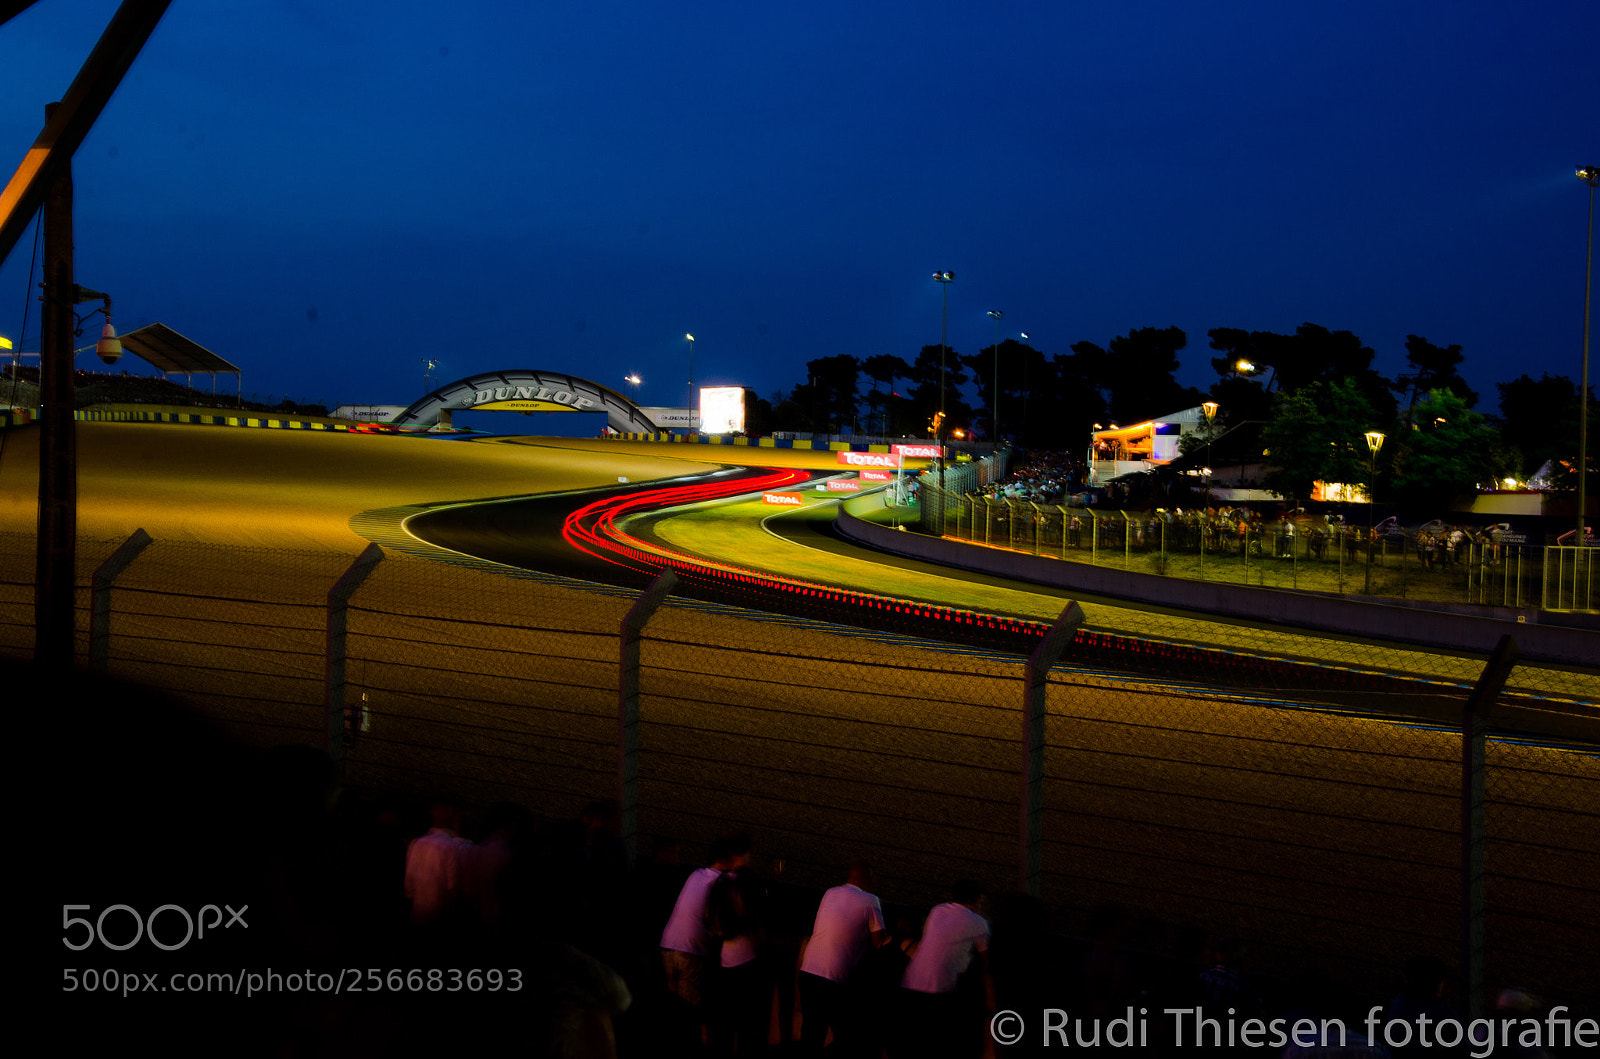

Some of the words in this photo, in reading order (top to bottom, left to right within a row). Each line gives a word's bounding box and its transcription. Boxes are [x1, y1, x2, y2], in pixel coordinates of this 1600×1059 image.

[473, 386, 595, 409] DUNLOP
[896, 445, 941, 457] TOTAL
[843, 452, 898, 468] TOTAL
[863, 472, 888, 480] TOTAL
[828, 481, 859, 491] TOTAL
[764, 494, 802, 504] TOTAL
